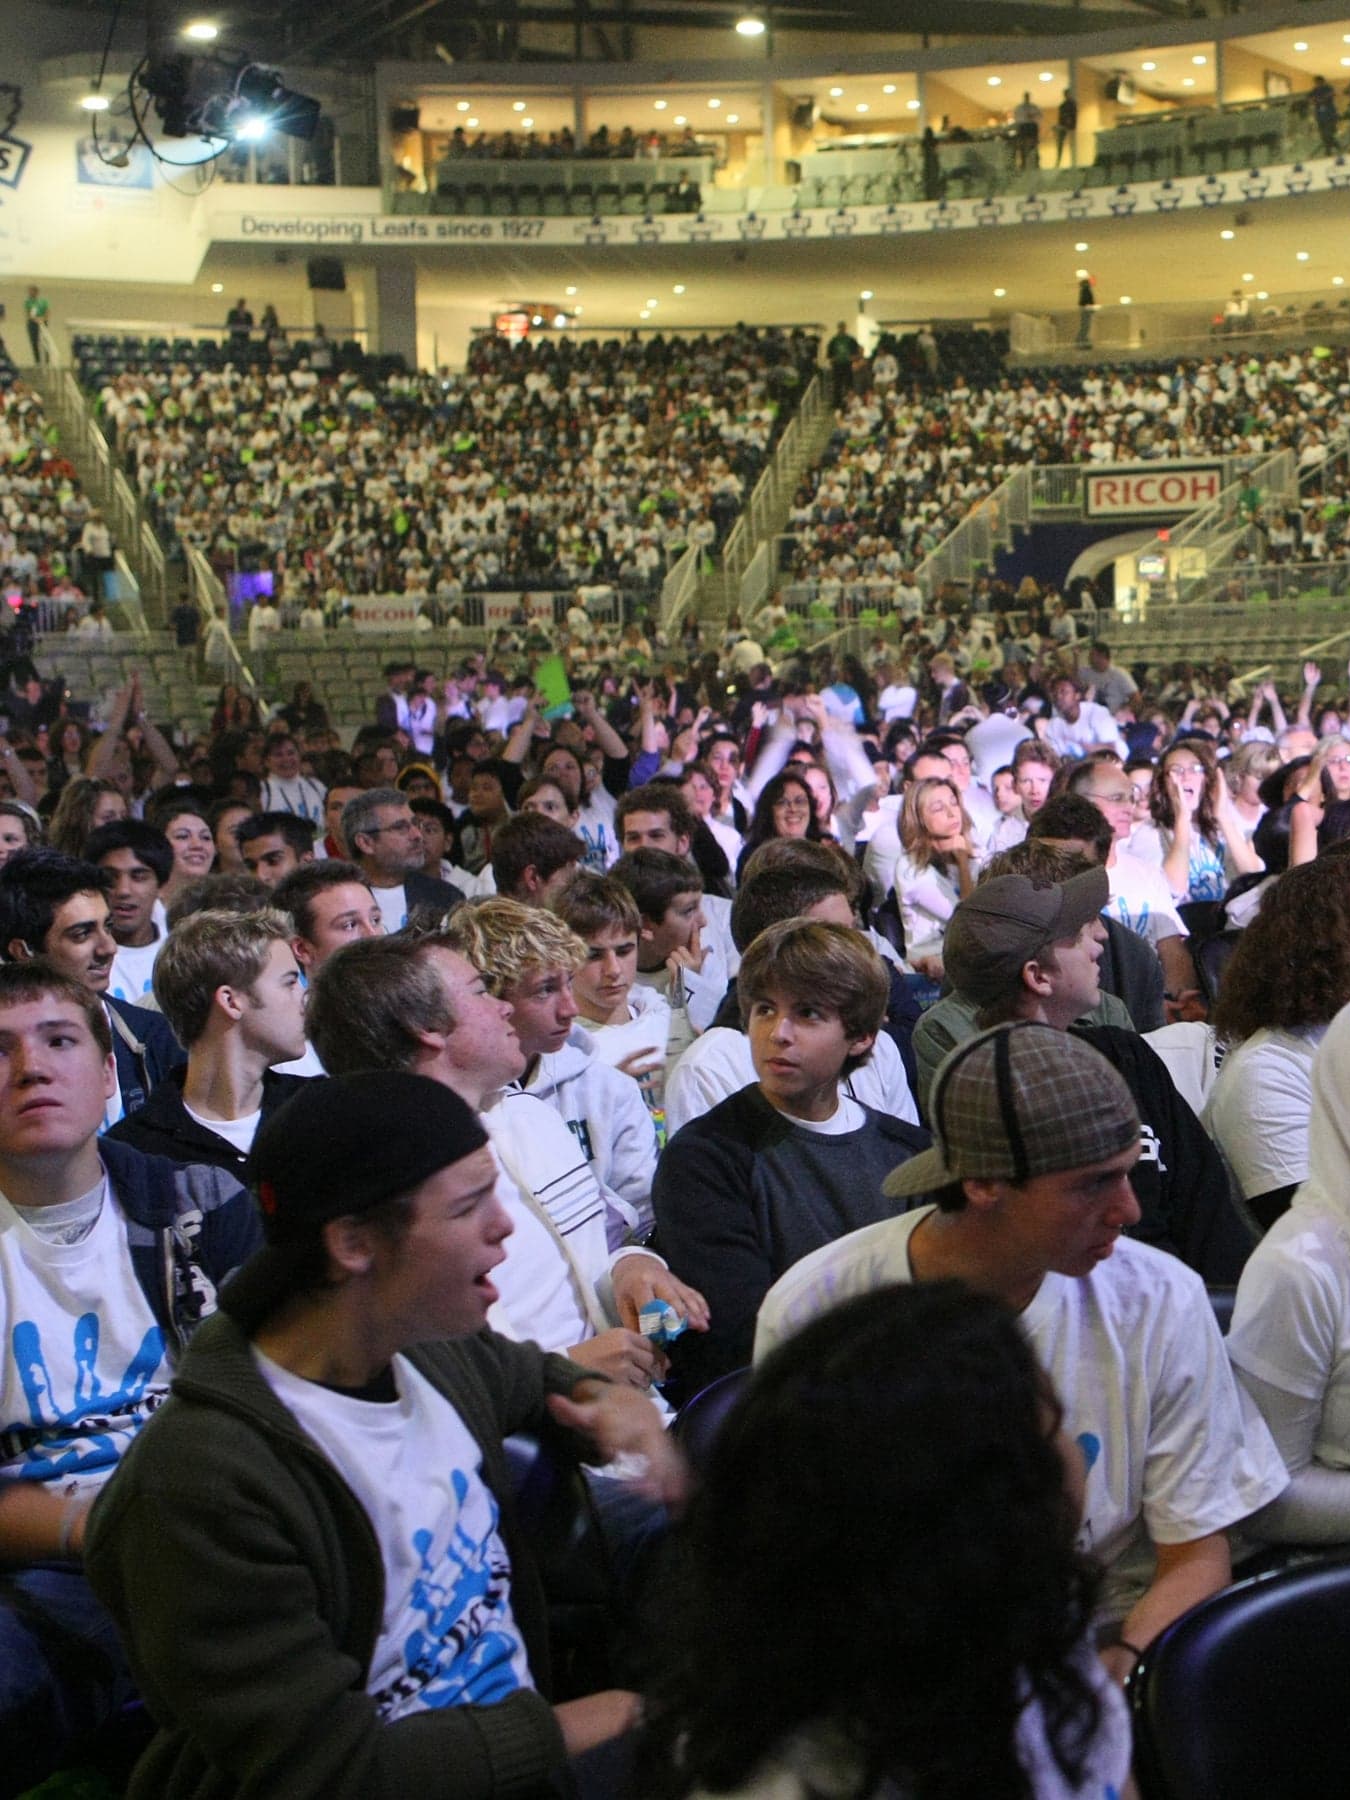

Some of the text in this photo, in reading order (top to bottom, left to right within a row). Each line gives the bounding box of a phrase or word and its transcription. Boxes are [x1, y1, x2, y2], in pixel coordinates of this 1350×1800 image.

[241, 216, 545, 243] Developing Leafs since 1927
[1095, 475, 1216, 507] RICOH
[488, 607, 551, 618] RIOH
